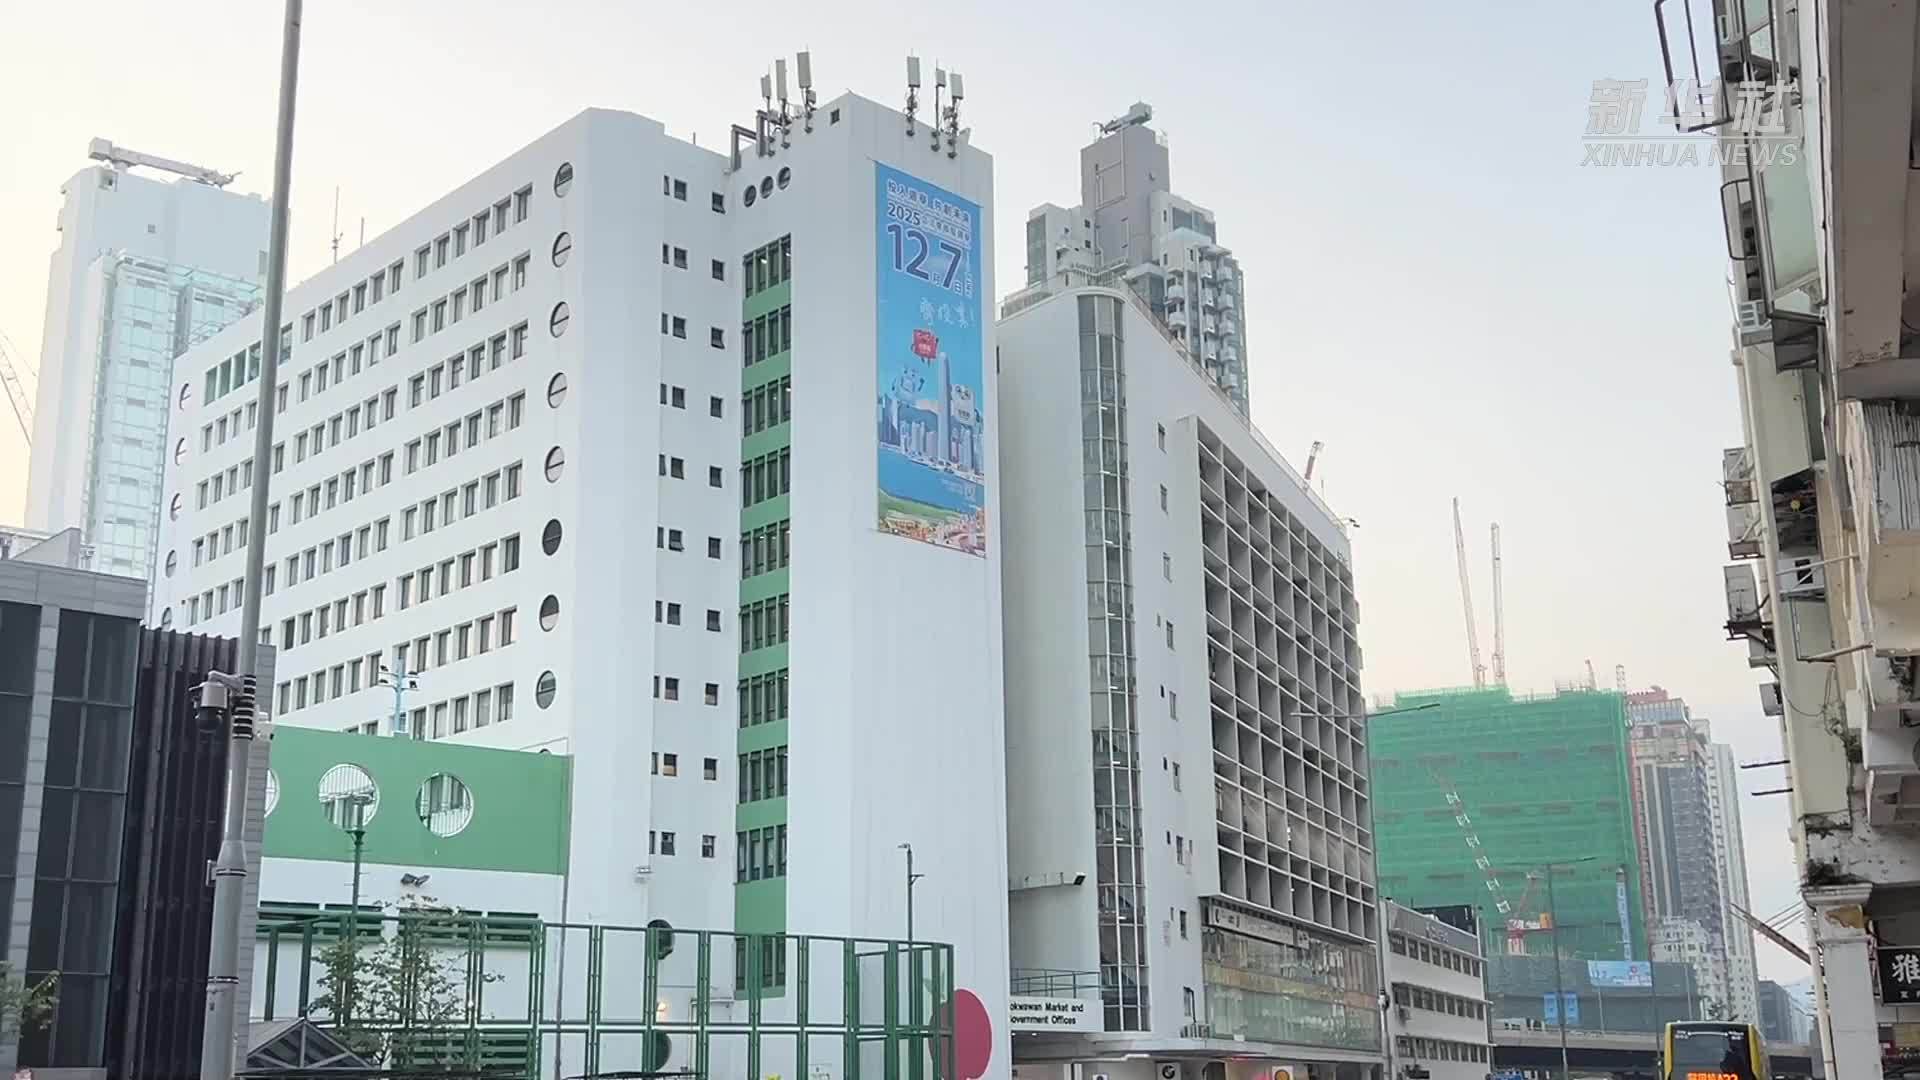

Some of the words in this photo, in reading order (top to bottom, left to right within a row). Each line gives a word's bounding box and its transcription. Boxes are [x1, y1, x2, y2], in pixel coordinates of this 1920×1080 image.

[887, 201, 921, 226] 2025
[1892, 954, 1920, 985] 雅
[1009, 1002, 1042, 1012] okwawan
[1045, 1003, 1068, 1012] Market
[1071, 1003, 1084, 1012] and
[1010, 1015, 1048, 1025] overnment
[1051, 1015, 1077, 1025] Offices
